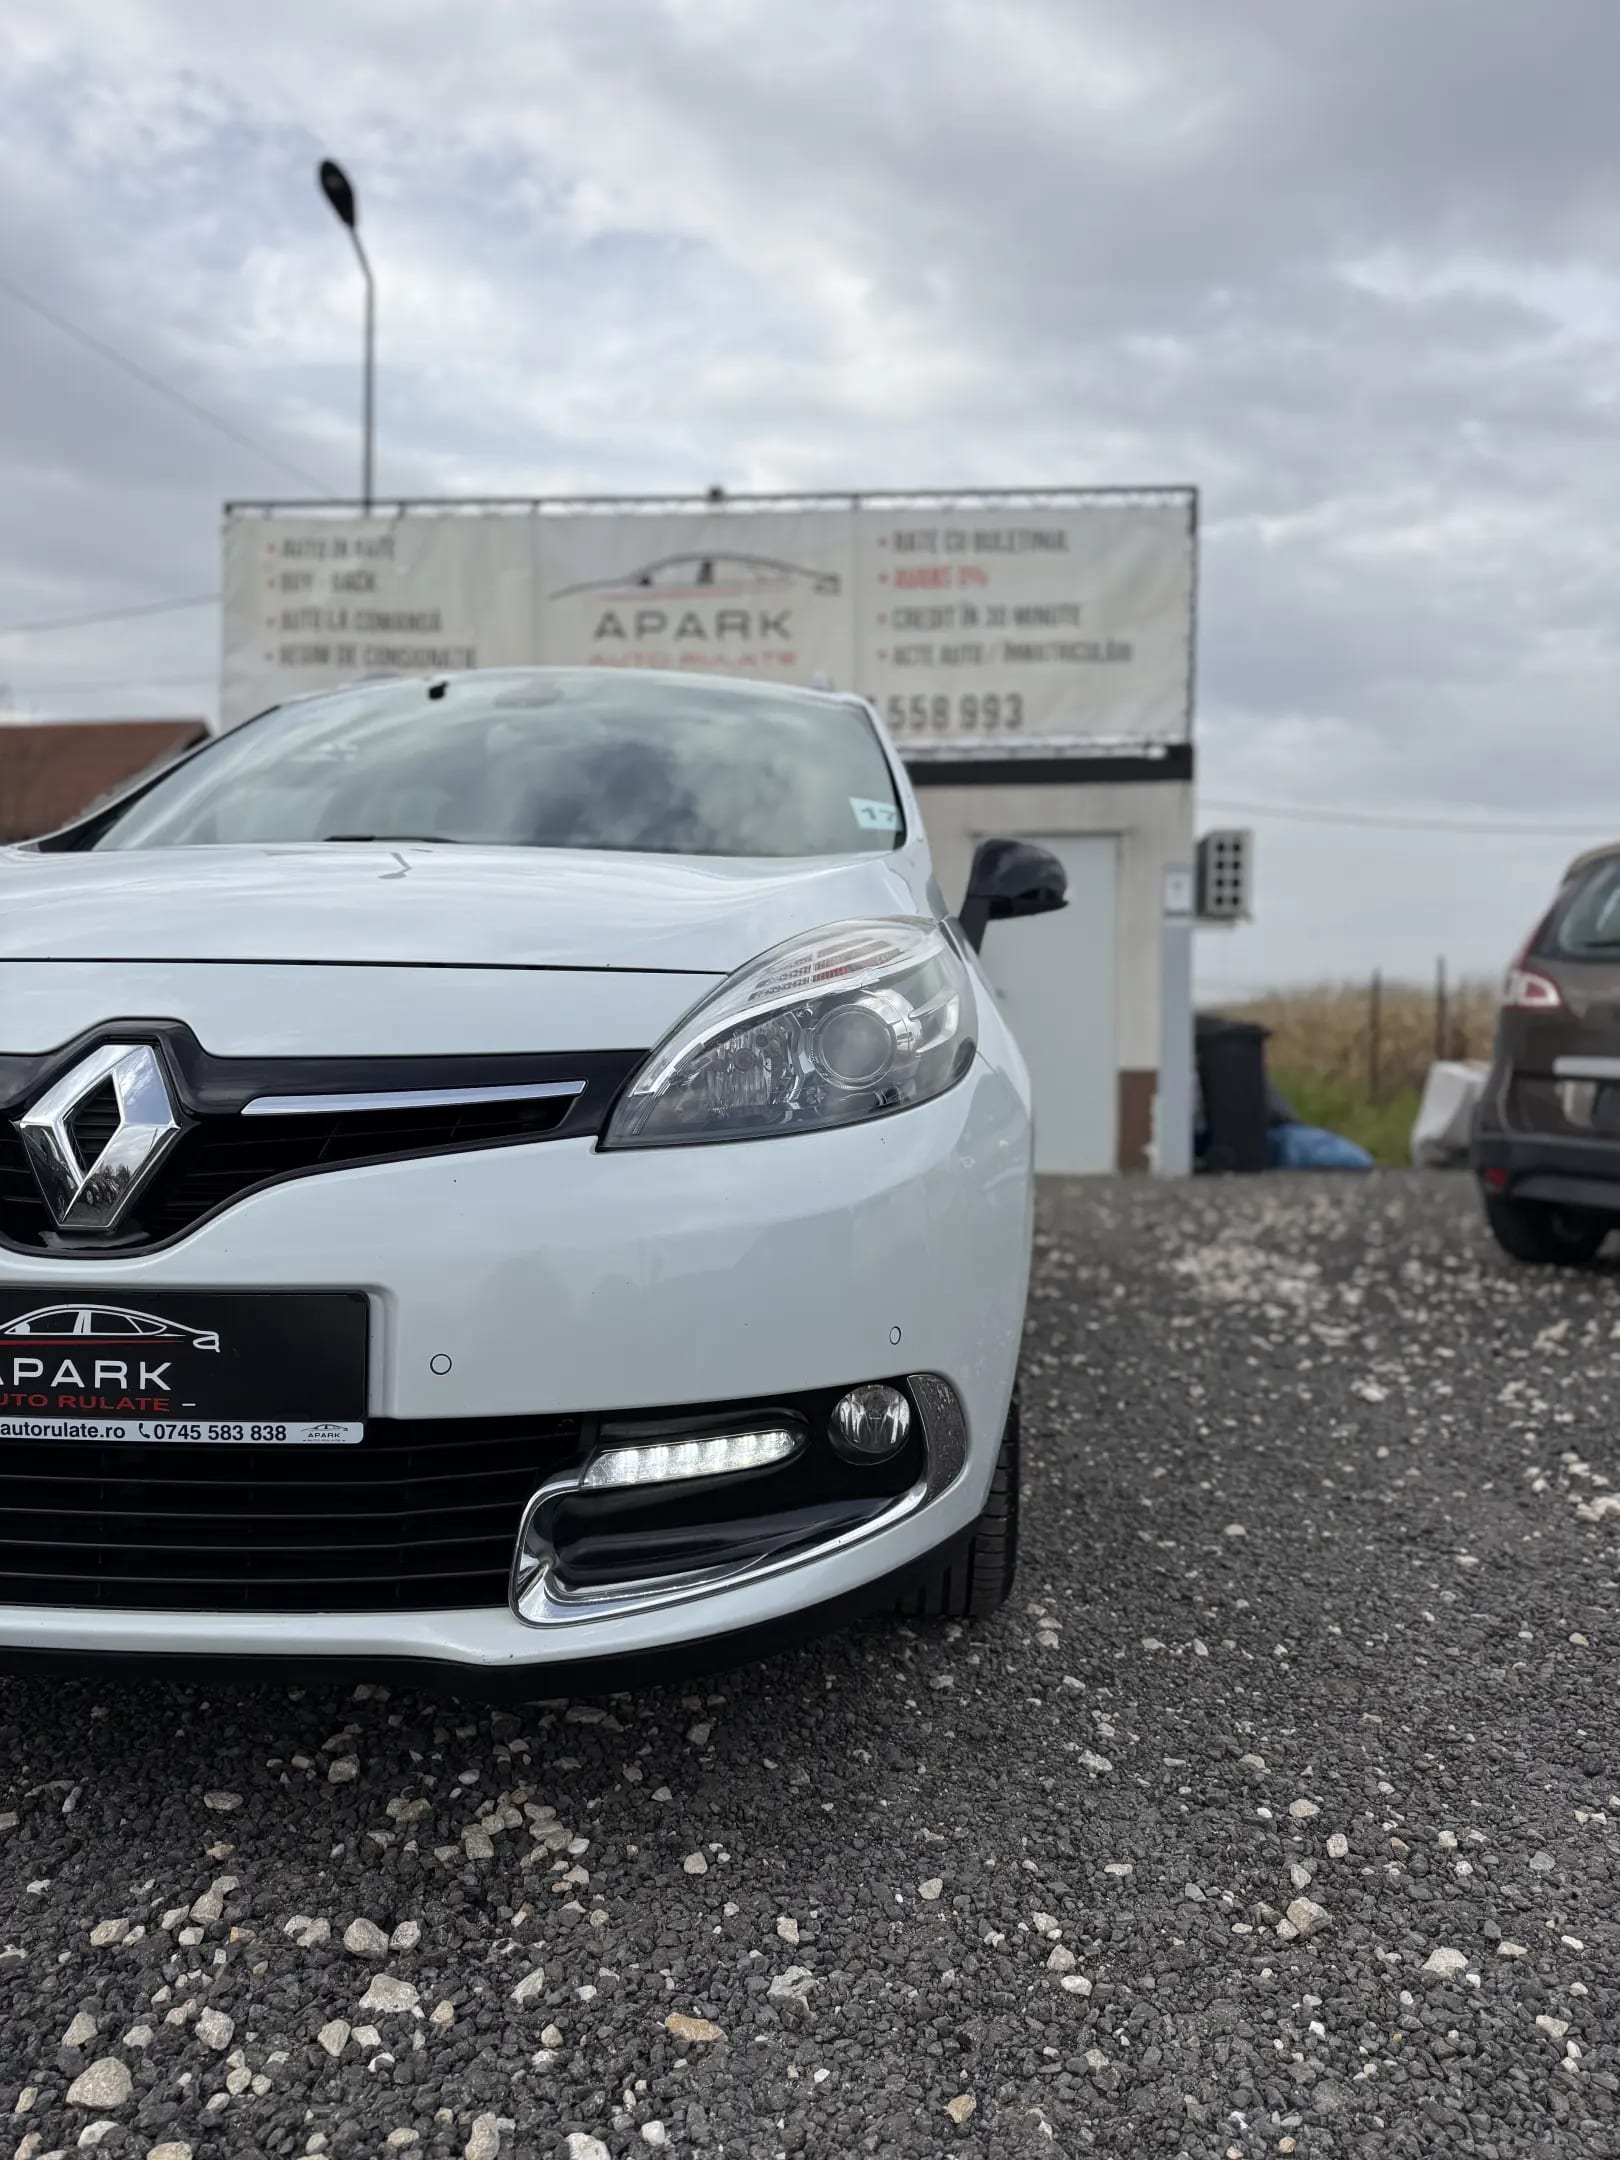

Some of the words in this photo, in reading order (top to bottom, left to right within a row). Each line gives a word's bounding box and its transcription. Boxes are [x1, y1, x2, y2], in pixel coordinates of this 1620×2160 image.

[593, 609, 793, 641] APARK
[887, 694, 949, 732] 558
[959, 692, 1023, 732] 993
[0, 1357, 172, 1391] PARK
[58, 1395, 170, 1412] RULATE
[0, 1422, 126, 1439] autorulate.ro
[154, 1424, 201, 1441] 0745
[208, 1425, 244, 1441] 583
[250, 1426, 287, 1441] 838
